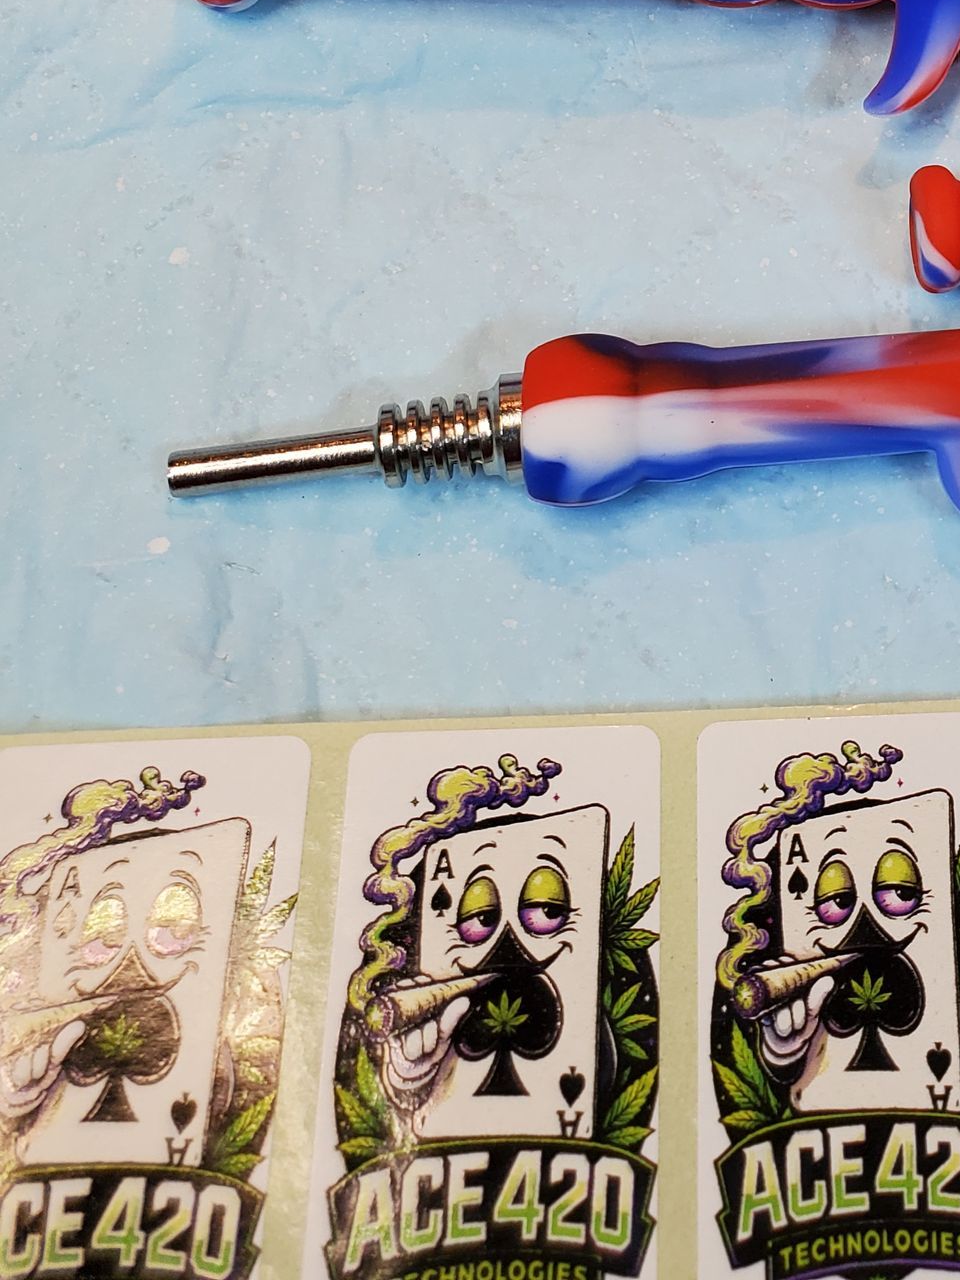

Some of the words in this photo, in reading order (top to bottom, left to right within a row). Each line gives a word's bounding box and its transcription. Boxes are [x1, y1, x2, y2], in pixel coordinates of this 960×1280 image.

[431, 849, 455, 881] A
[786, 833, 809, 864] A
[57, 866, 80, 900] A
[343, 1151, 490, 1272] ACE
[493, 1150, 634, 1253] 420
[738, 1128, 870, 1241] ACE
[0, 1177, 93, 1276] CE
[91, 1177, 241, 1280] 420
